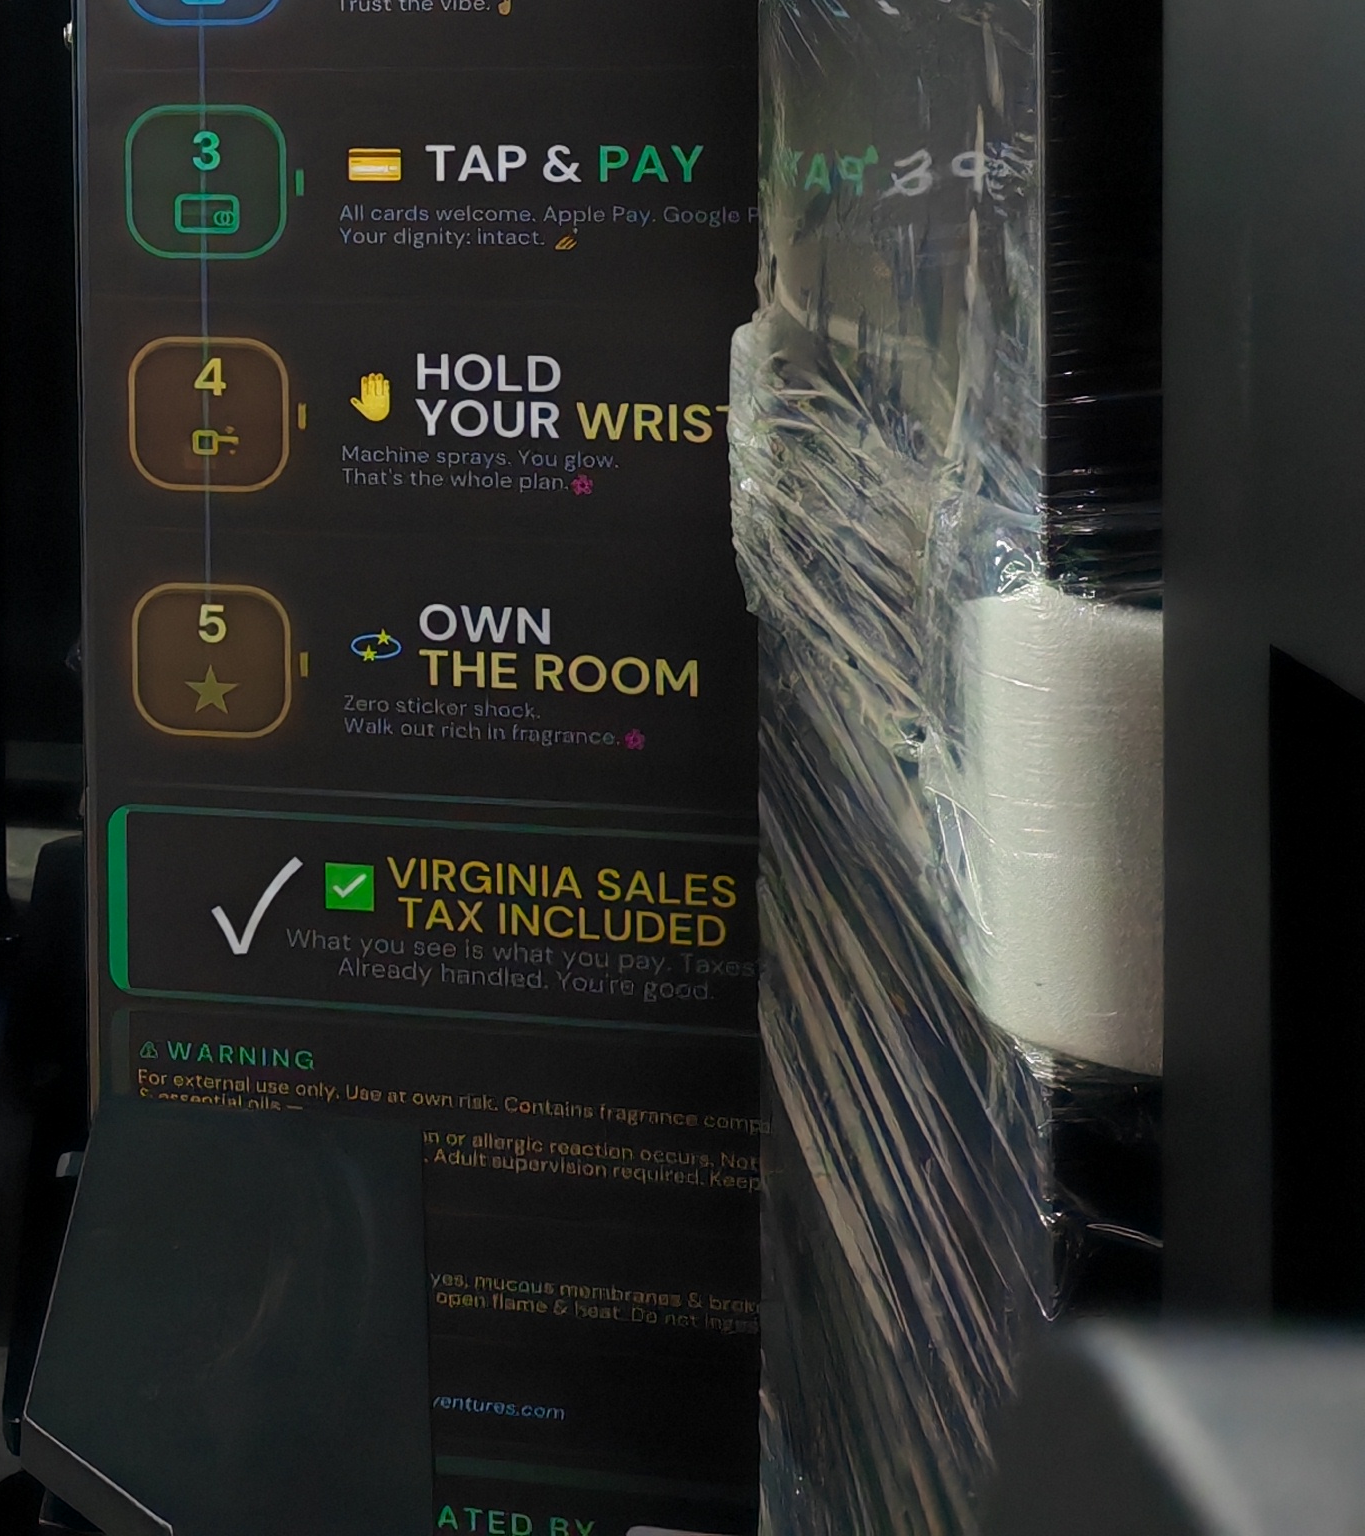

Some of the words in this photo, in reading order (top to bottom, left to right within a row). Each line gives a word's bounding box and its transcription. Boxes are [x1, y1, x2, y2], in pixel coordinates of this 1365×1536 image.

[192, 130, 221, 172] 3
[425, 144, 527, 183] TAP
[542, 144, 582, 183] &
[599, 144, 704, 183] PAY
[339, 205, 364, 222] All
[371, 205, 429, 222] cards
[435, 205, 536, 223] welcome.
[543, 205, 605, 226] Apple
[612, 206, 656, 227] Pay.
[663, 206, 741, 228] Google
[340, 228, 386, 246] Your
[394, 227, 471, 250] dignity:
[477, 229, 545, 246] intact.
[193, 357, 227, 397] 4
[416, 353, 562, 393] HOLD
[414, 398, 560, 439] YOUR
[341, 445, 429, 465] Machine
[436, 447, 512, 468] sprays.
[518, 449, 558, 467] You
[564, 451, 619, 472] glow.
[342, 468, 404, 487] That's
[409, 469, 443, 487] the
[450, 471, 512, 490] whole
[519, 472, 569, 493] plan.
[197, 604, 227, 645] 5
[419, 603, 551, 645] OWN
[419, 648, 518, 690] THE
[534, 653, 699, 698] ROOM
[343, 695, 389, 713] Zero
[395, 697, 467, 717] sticker
[474, 694, 541, 720] shock.
[343, 718, 394, 736] Walk
[400, 721, 434, 738] out
[441, 721, 481, 740] rich
[487, 722, 506, 741] in
[512, 724, 621, 747] fragrance.
[386, 856, 582, 900] VIRGINIA
[597, 868, 737, 909] SALES
[397, 896, 483, 933] TAX
[499, 903, 727, 948] INCLUDED
[286, 927, 351, 952] What
[360, 937, 405, 958] you
[414, 939, 457, 958] see
[465, 941, 484, 960] is
[492, 943, 553, 964] what
[561, 948, 609, 971] you
[618, 952, 671, 976] pay.
[338, 957, 432, 987] Already
[440, 963, 549, 990] handled.
[642, 979, 714, 1003] good.
[166, 1040, 315, 1071] WARNING
[137, 1068, 167, 1087] For
[173, 1073, 249, 1094] external
[256, 1081, 289, 1095] use
[296, 1082, 341, 1103] only.
[345, 1083, 382, 1103] Use
[387, 1091, 407, 1105] at
[412, 1091, 452, 1107] own
[504, 1096, 593, 1120] Contains
[599, 1103, 697, 1127] fragrance
[434, 1149, 487, 1168] Adult
[492, 1154, 608, 1178] supervision
[446, 1135, 467, 1147] or
[472, 1135, 543, 1156] allergic
[549, 1141, 633, 1162] reaction
[474, 1274, 555, 1295] mucous
